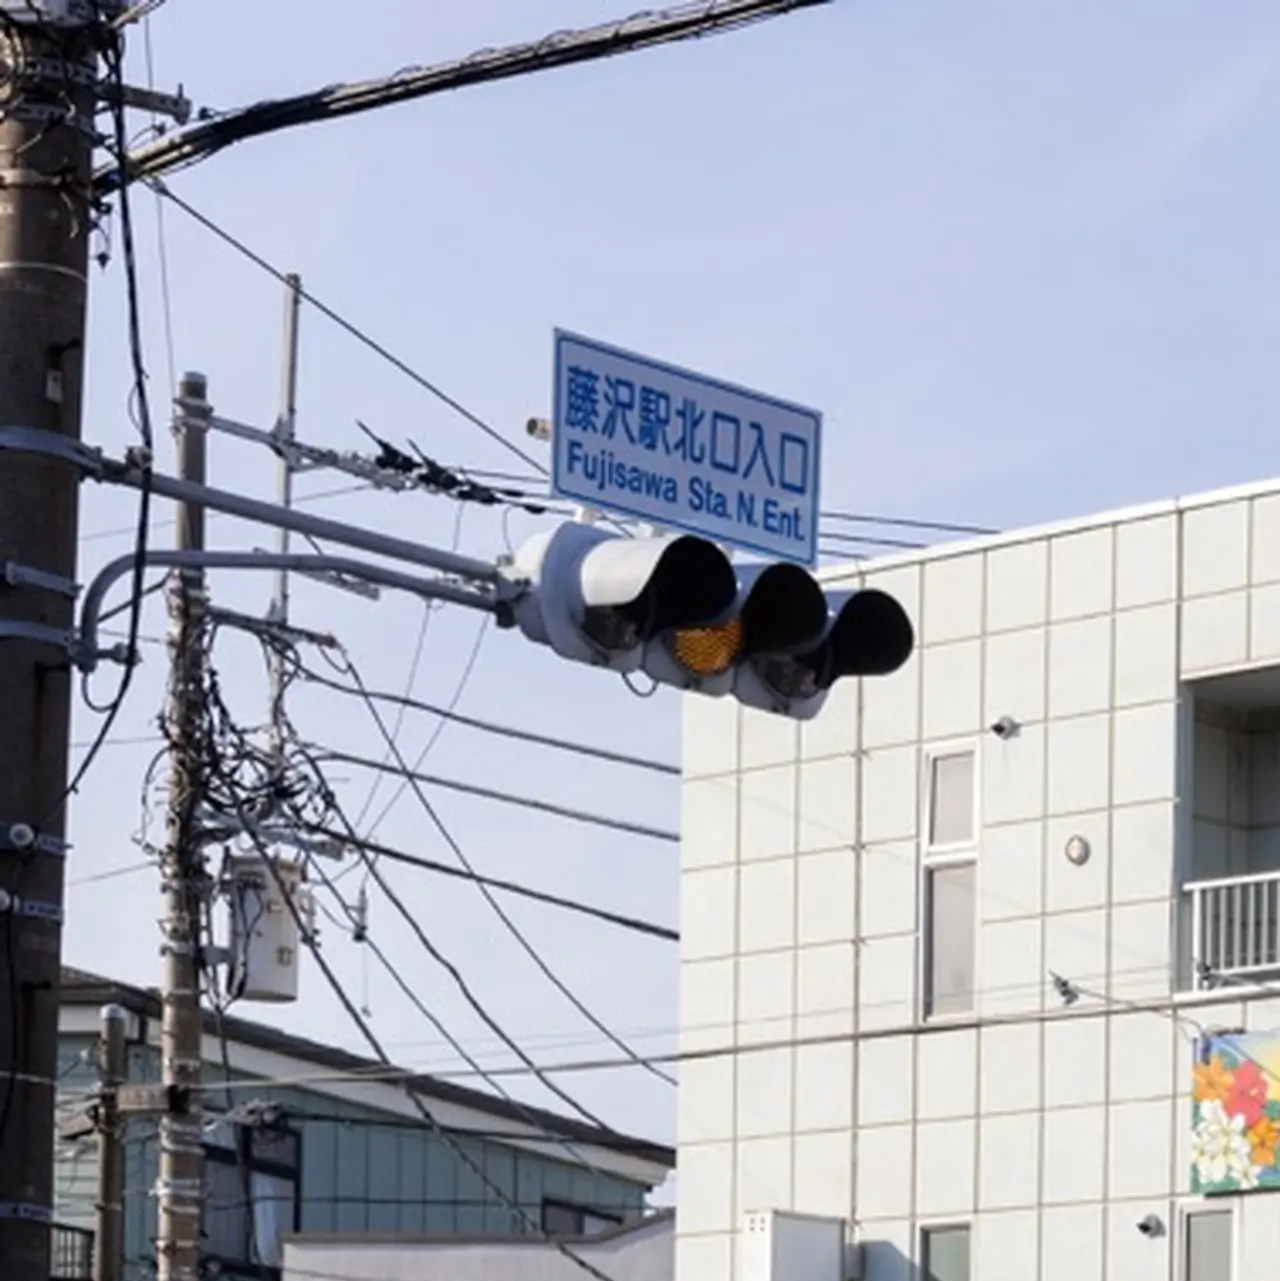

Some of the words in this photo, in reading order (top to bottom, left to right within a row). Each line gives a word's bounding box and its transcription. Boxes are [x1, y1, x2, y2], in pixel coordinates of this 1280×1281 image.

[565, 364, 809, 495] 藤沢駅北口入口
[567, 440, 678, 503] Fujisawa
[688, 475, 734, 520] Sta.
[737, 492, 759, 527] N.
[763, 499, 806, 542] Ent.
